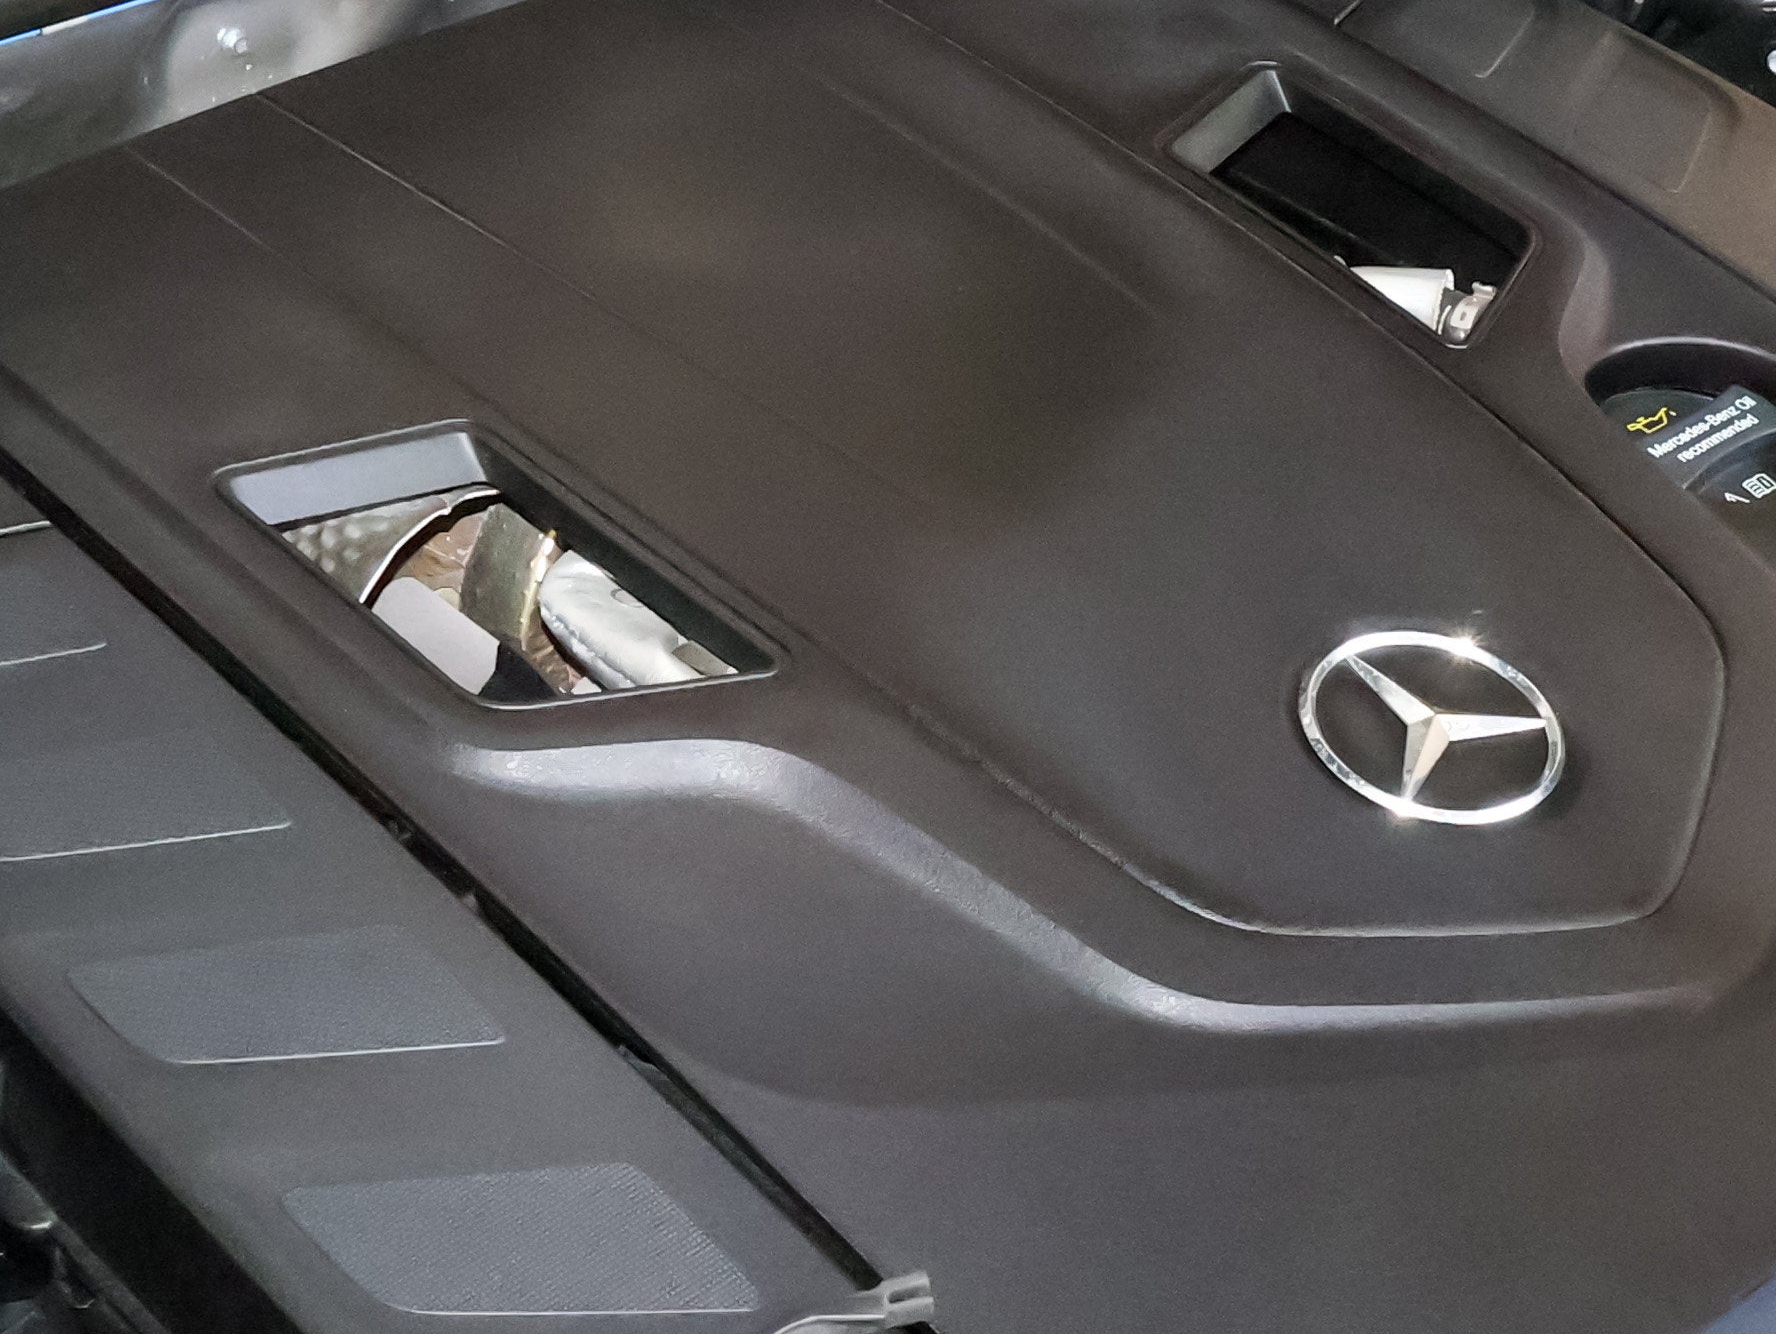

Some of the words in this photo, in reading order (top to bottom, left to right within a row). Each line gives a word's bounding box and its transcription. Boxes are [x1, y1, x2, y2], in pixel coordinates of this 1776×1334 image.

[1647, 406, 1741, 458] Mercedes-Benz
[1734, 395, 1757, 410] Oil
[1676, 413, 1759, 462] recommended
